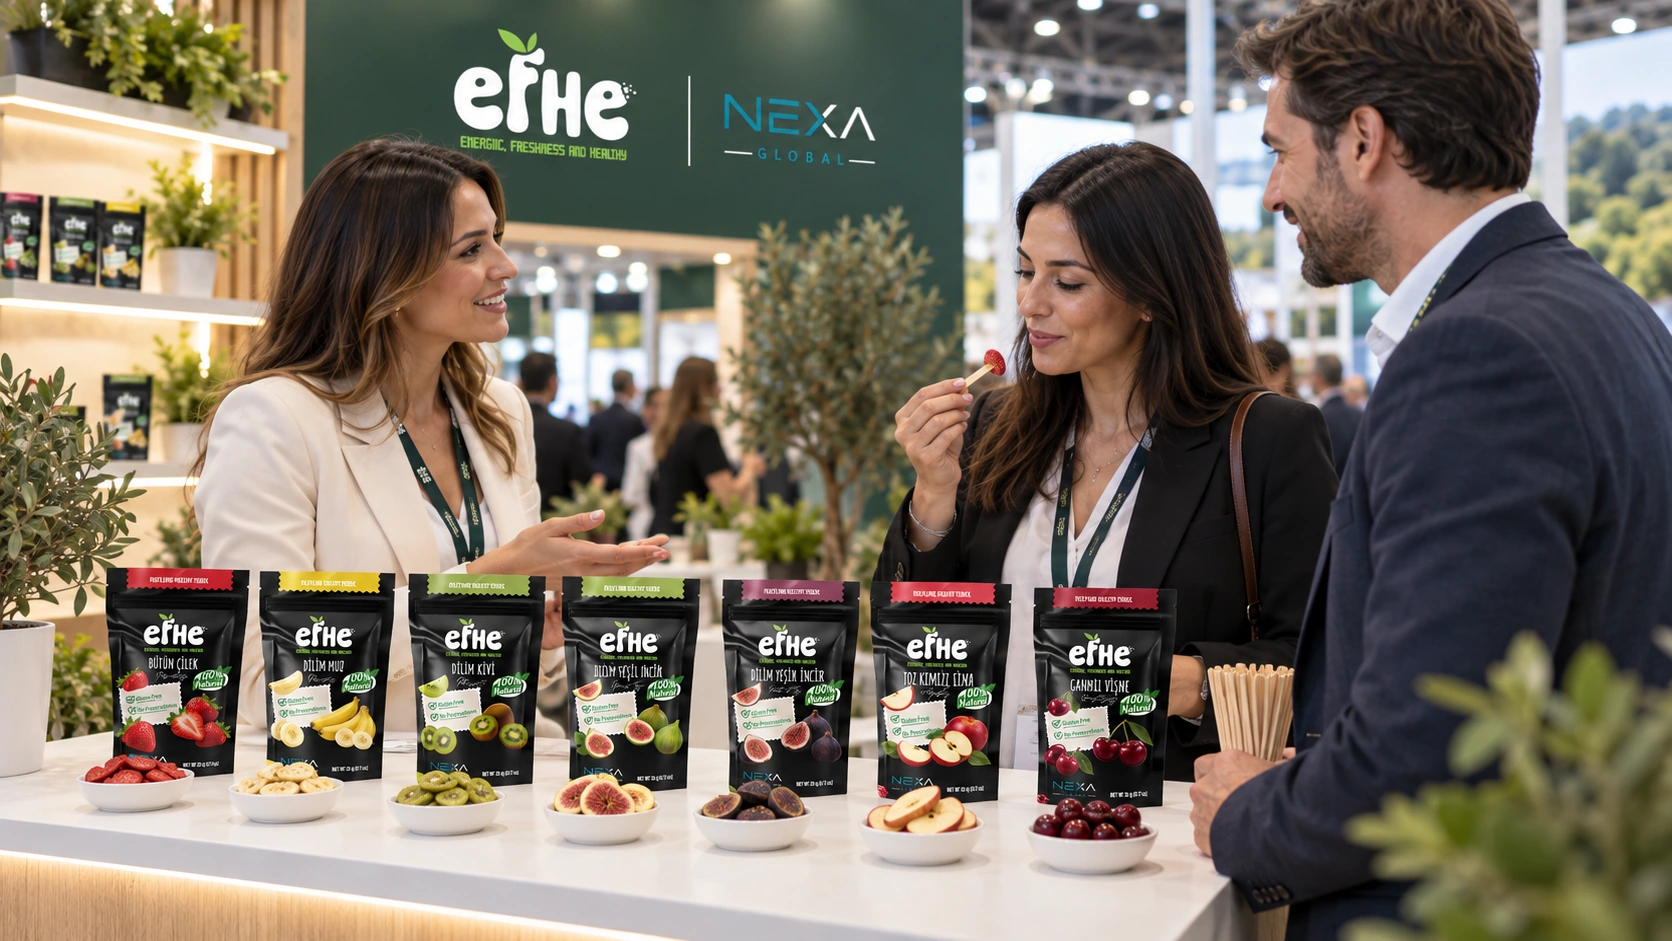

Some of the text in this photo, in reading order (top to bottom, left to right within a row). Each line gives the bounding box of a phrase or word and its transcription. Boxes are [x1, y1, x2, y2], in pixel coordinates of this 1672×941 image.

[724, 93, 876, 142] NEXA
[569, 146, 587, 158] AND
[757, 147, 844, 166] GLOBAL
[176, 655, 199, 674] ÇİLEK
[451, 661, 495, 676] DİLİM KİVİ
[743, 771, 783, 782] NEXA
[891, 775, 934, 787] NEXA
[1052, 780, 1096, 792] NEXA
